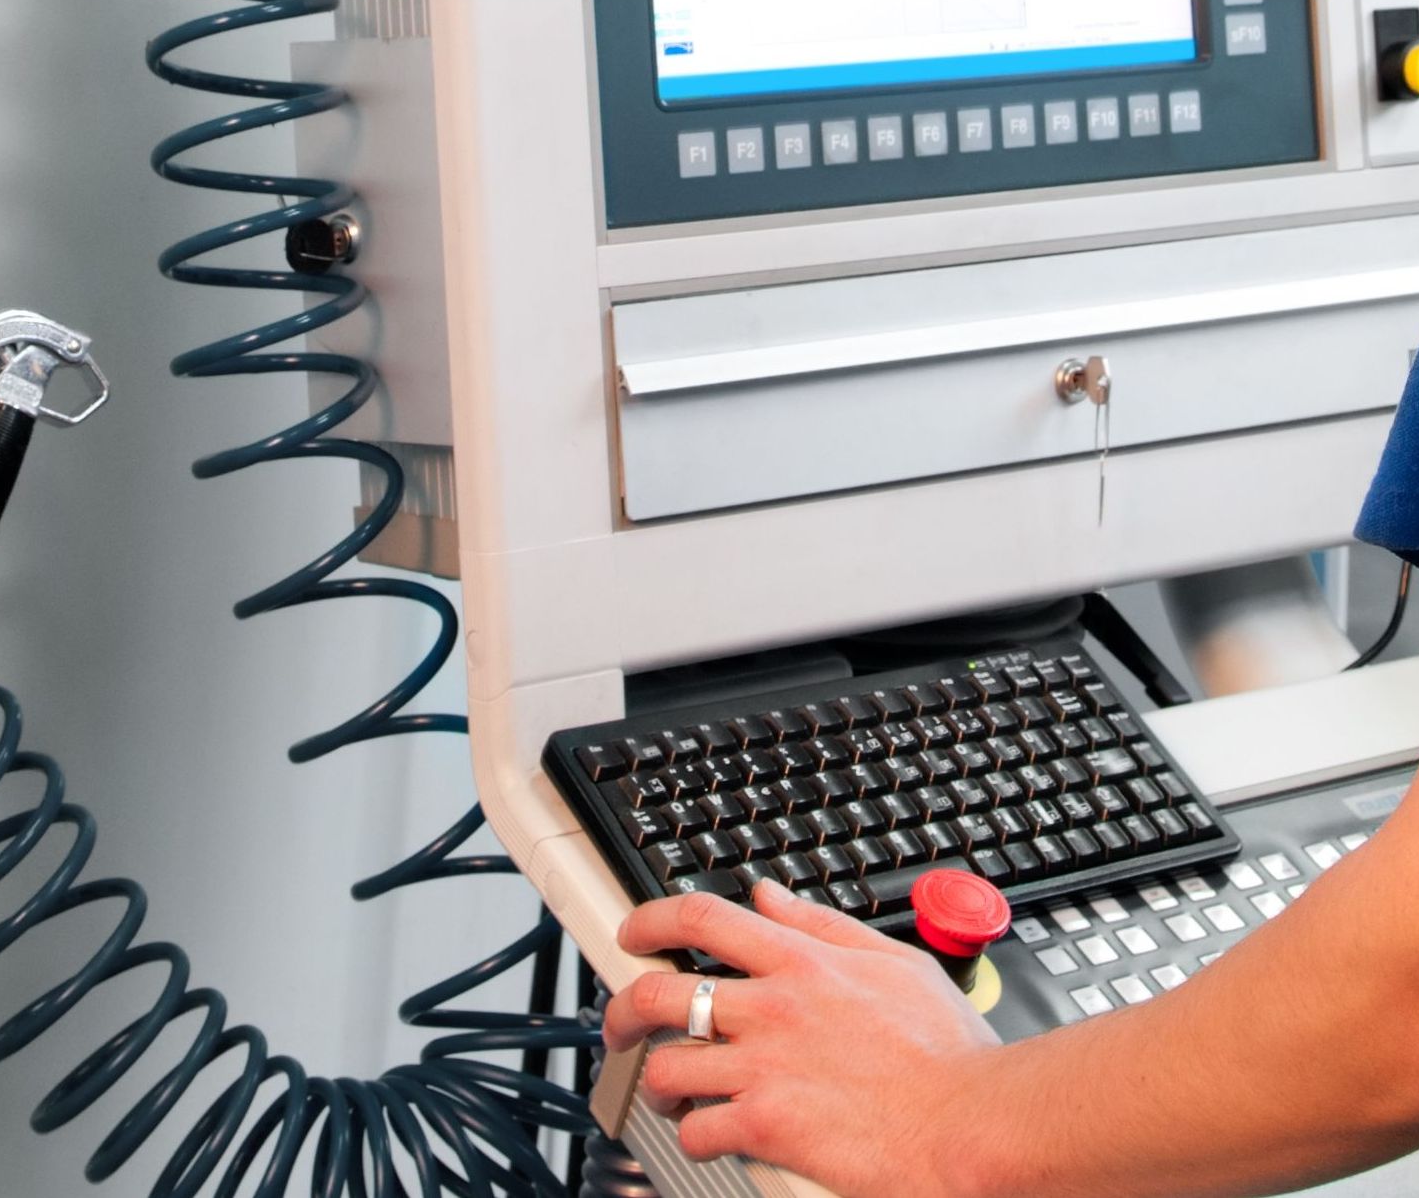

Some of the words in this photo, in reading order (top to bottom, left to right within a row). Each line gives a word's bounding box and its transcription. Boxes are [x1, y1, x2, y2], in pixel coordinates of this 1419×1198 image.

[689, 147, 707, 163] F1
[737, 142, 755, 159] F2
[784, 138, 803, 154] F3
[831, 134, 849, 150] F4
[876, 130, 895, 146] F5
[922, 126, 941, 142] F6
[966, 122, 984, 139] F7
[1010, 118, 1028, 134] F8
[1053, 115, 1071, 131] F9
[1091, 111, 1116, 127] F10
[1134, 108, 1157, 123] F11
[1174, 104, 1197, 120] F12
[671, 801, 685, 813] Q
[708, 794, 723, 806] W
[743, 787, 758, 799] E
[703, 833, 717, 846] A
[740, 825, 753, 838] S
[776, 817, 790, 830] D
